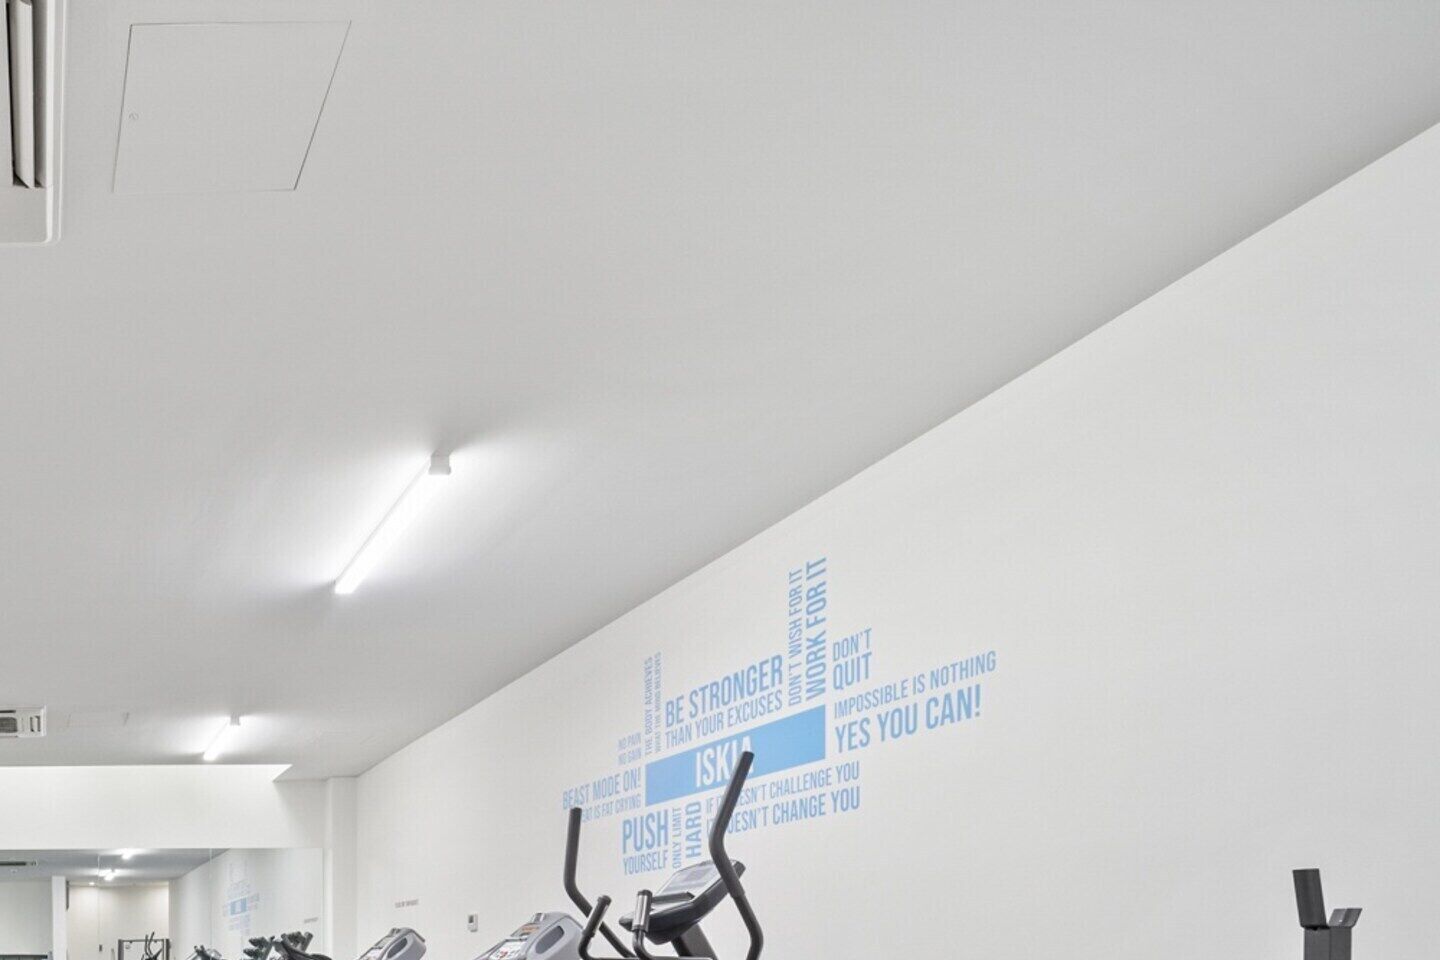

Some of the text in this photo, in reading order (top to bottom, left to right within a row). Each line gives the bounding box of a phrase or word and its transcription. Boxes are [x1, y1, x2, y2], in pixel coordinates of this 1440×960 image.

[788, 568, 803, 707] DON'T WISH FOR IT
[805, 557, 827, 702] WORK FOR IT
[832, 627, 872, 662] DON'T
[665, 654, 783, 728] BE STRONGER
[832, 651, 872, 691] QUIT
[834, 650, 997, 720] IMPOSSIBLE IS NOTHING
[665, 689, 783, 749] THAN YOUR EXCUSES
[835, 683, 982, 754] YES YOU CAN!
[562, 766, 641, 811] BEAST MODE ON!
[769, 767, 832, 798] CHALLENGE
[835, 760, 860, 785] YOU
[622, 808, 669, 855] PUSH
[672, 807, 682, 870] ONLY LIMIT
[685, 801, 702, 859] HARD
[727, 805, 770, 834] OESN'T
[772, 793, 827, 825] CHANGE
[831, 786, 861, 811] YOU
[623, 849, 669, 876] YOURSELF
